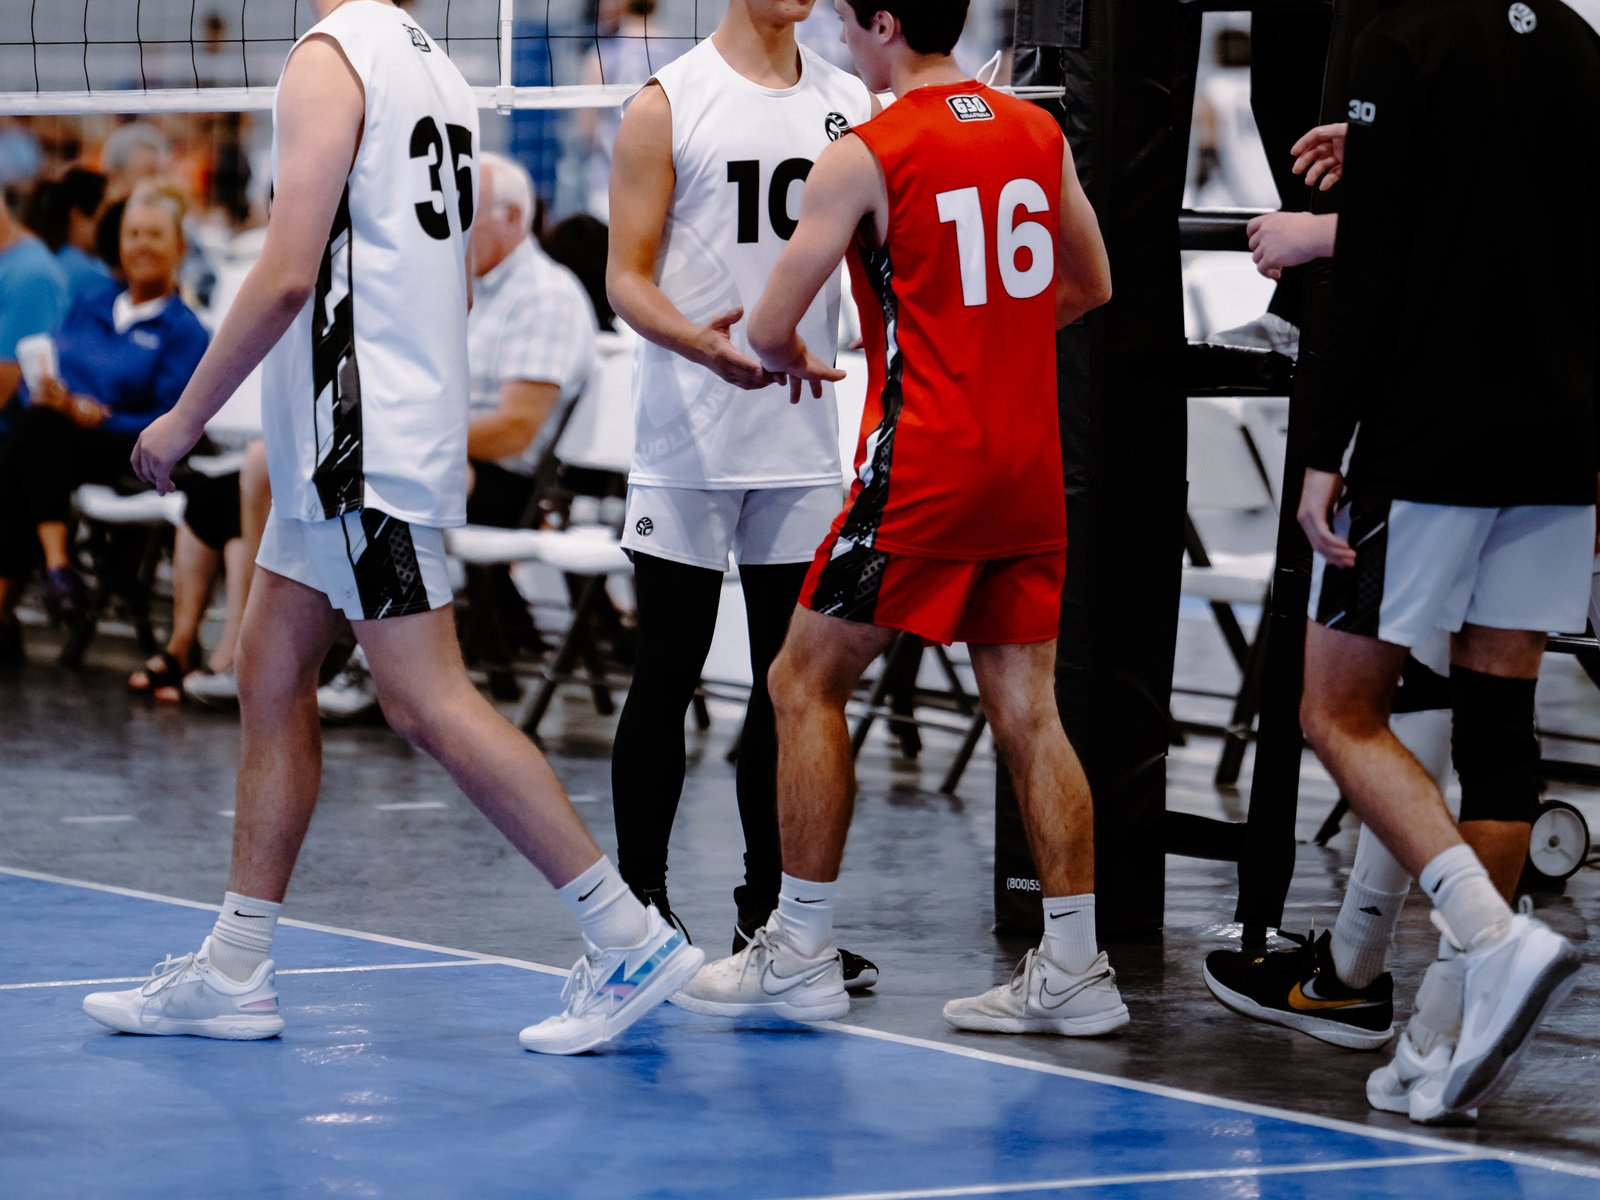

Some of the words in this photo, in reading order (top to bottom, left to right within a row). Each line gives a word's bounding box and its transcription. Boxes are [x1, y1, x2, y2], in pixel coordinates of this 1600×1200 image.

[952, 97, 987, 114] 630
[1348, 99, 1376, 122] 30
[409, 115, 473, 240] 35
[727, 157, 814, 244] 10
[935, 178, 1054, 306] 16
